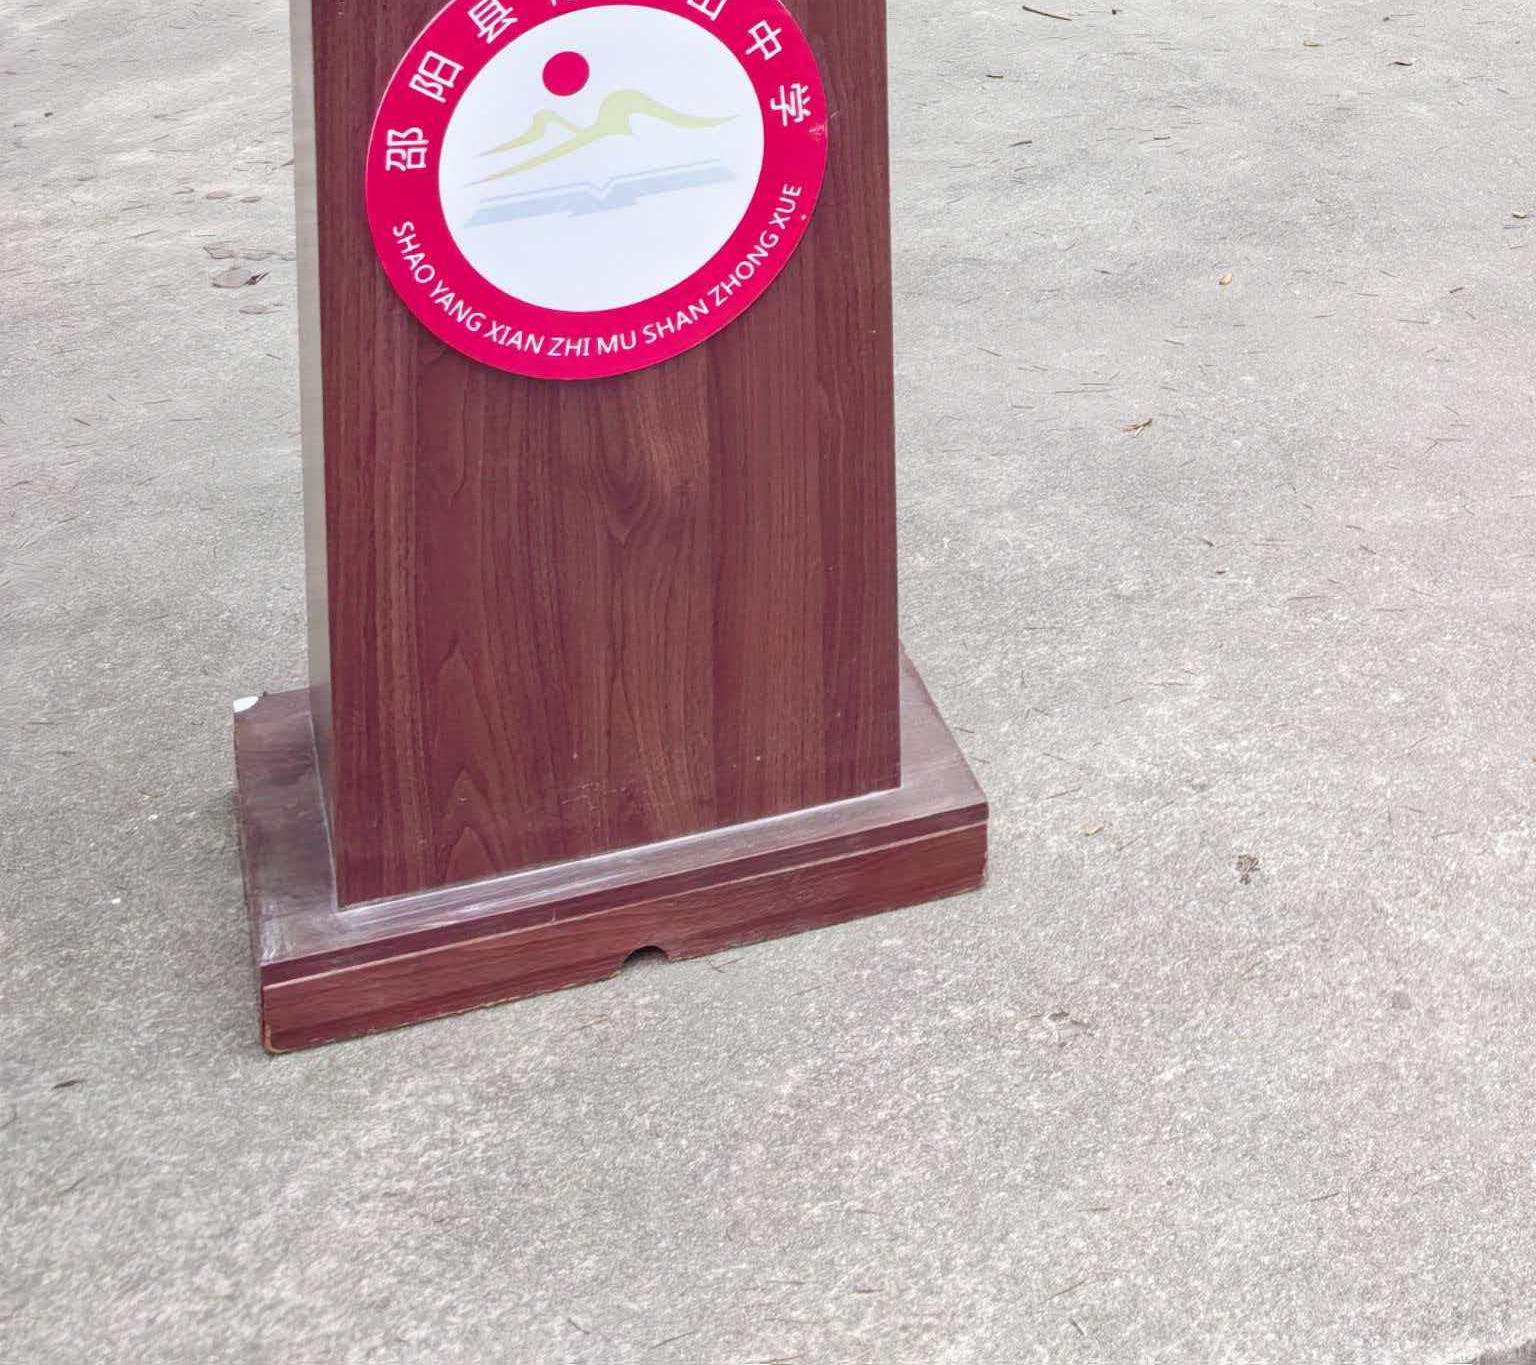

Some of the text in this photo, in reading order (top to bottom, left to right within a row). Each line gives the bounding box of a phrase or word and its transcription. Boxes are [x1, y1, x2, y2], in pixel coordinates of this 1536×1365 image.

[392, 183, 802, 357] SHAO YANG XIAN ZHI MU SHAN ZHONG XUE
